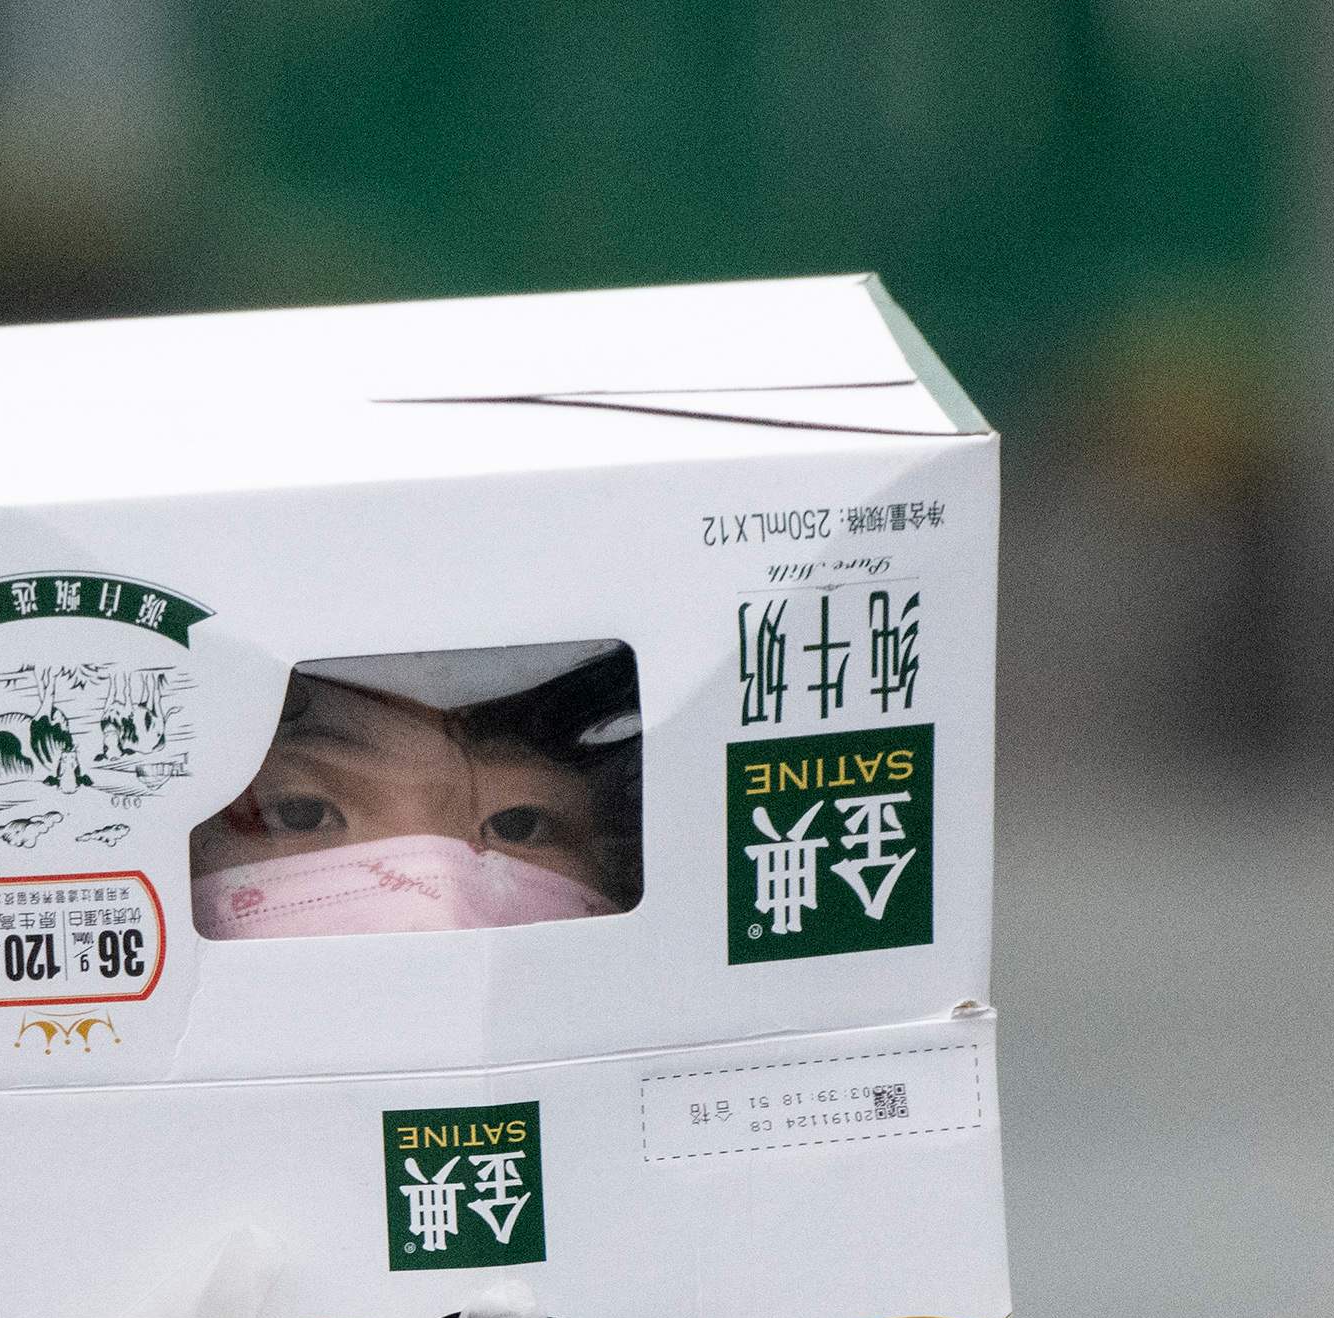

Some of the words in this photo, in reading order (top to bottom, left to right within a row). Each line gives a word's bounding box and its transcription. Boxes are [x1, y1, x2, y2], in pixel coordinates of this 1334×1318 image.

[767, 562, 826, 582] Milk
[832, 556, 893, 575] Pure
[737, 590, 921, 726] 纯牛奶
[743, 749, 915, 795] SATINE
[744, 789, 917, 935] 金典
[68, 908, 142, 927] 优质乳蛋白
[4, 934, 61, 982] 120
[98, 929, 145, 979] 3.6
[689, 1100, 733, 1125] 合格
[749, 1119, 772, 1132] C8
[785, 1110, 873, 1129] 20191124
[395, 1119, 527, 1150] SATINE
[398, 1149, 532, 1252] 金典
